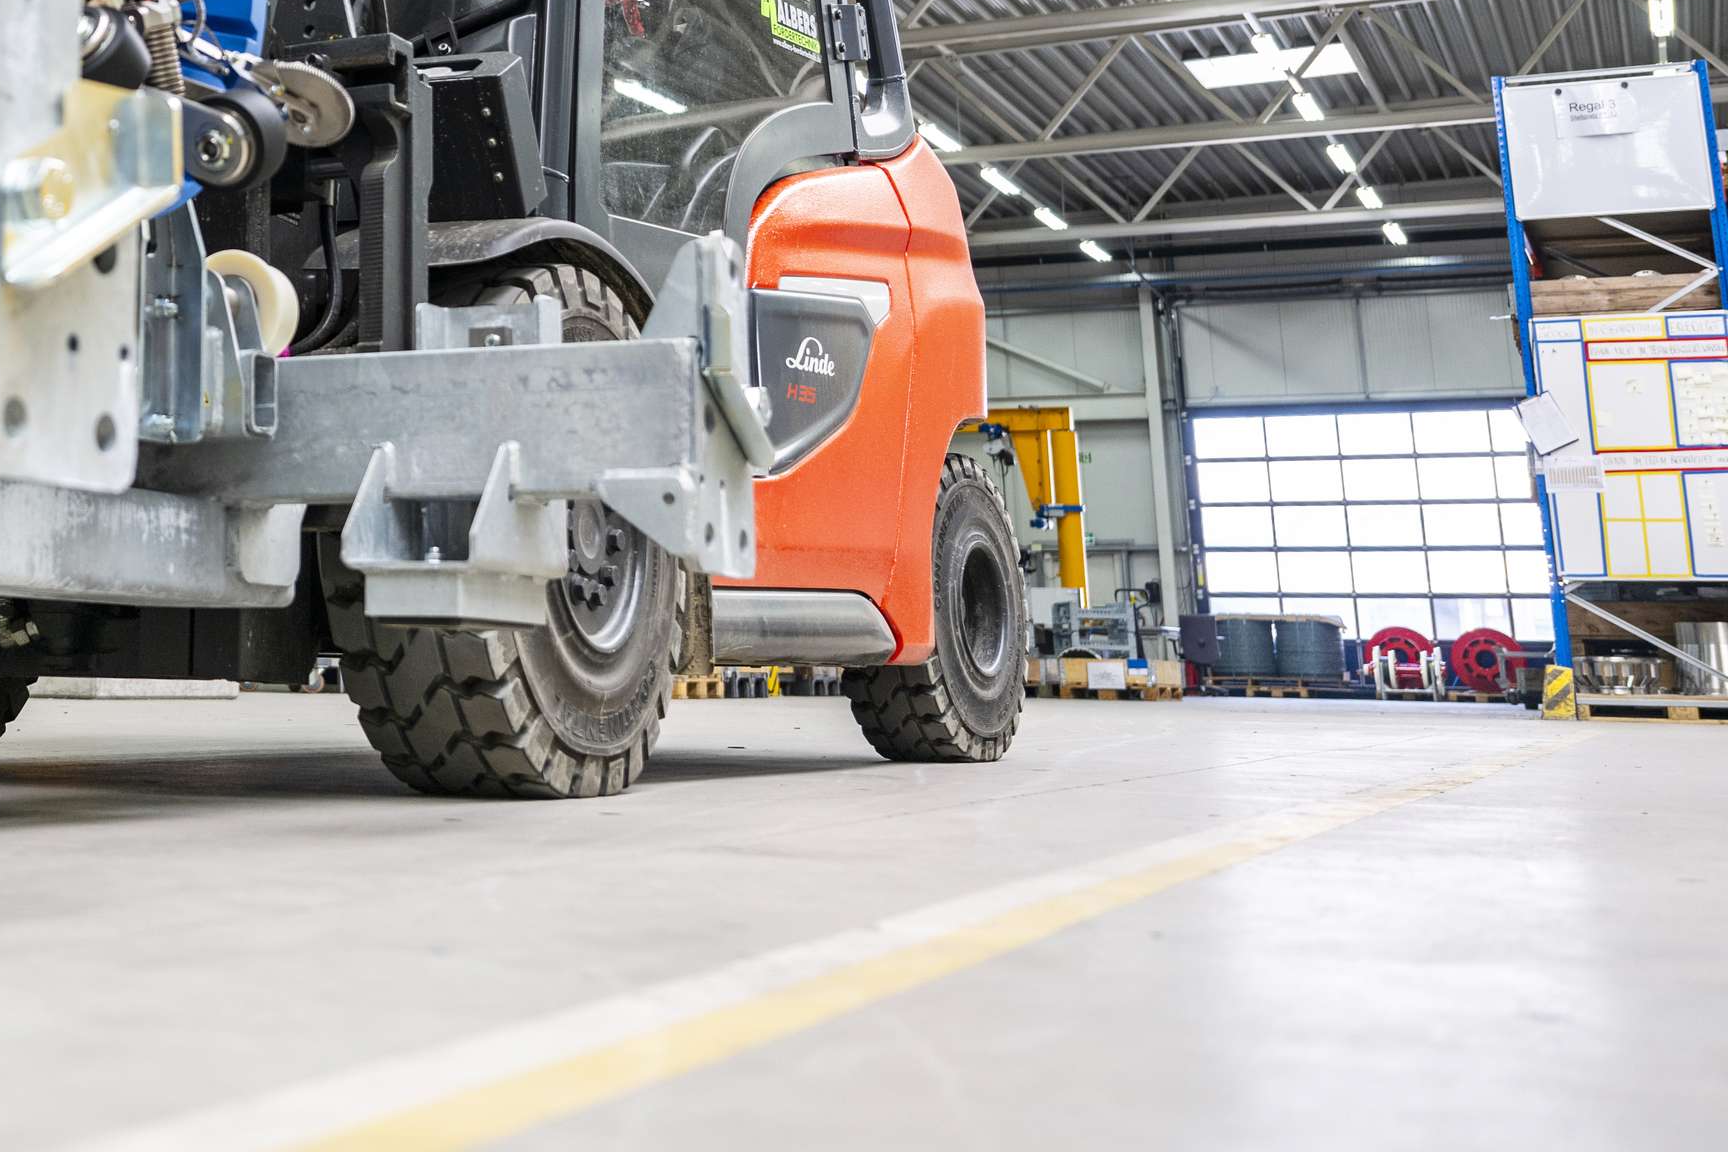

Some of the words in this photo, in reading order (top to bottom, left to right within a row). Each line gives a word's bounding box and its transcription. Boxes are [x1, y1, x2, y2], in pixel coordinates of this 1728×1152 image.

[777, 0, 818, 38] ALBERS
[1569, 100, 1605, 113] Regal
[785, 336, 836, 377] Linde
